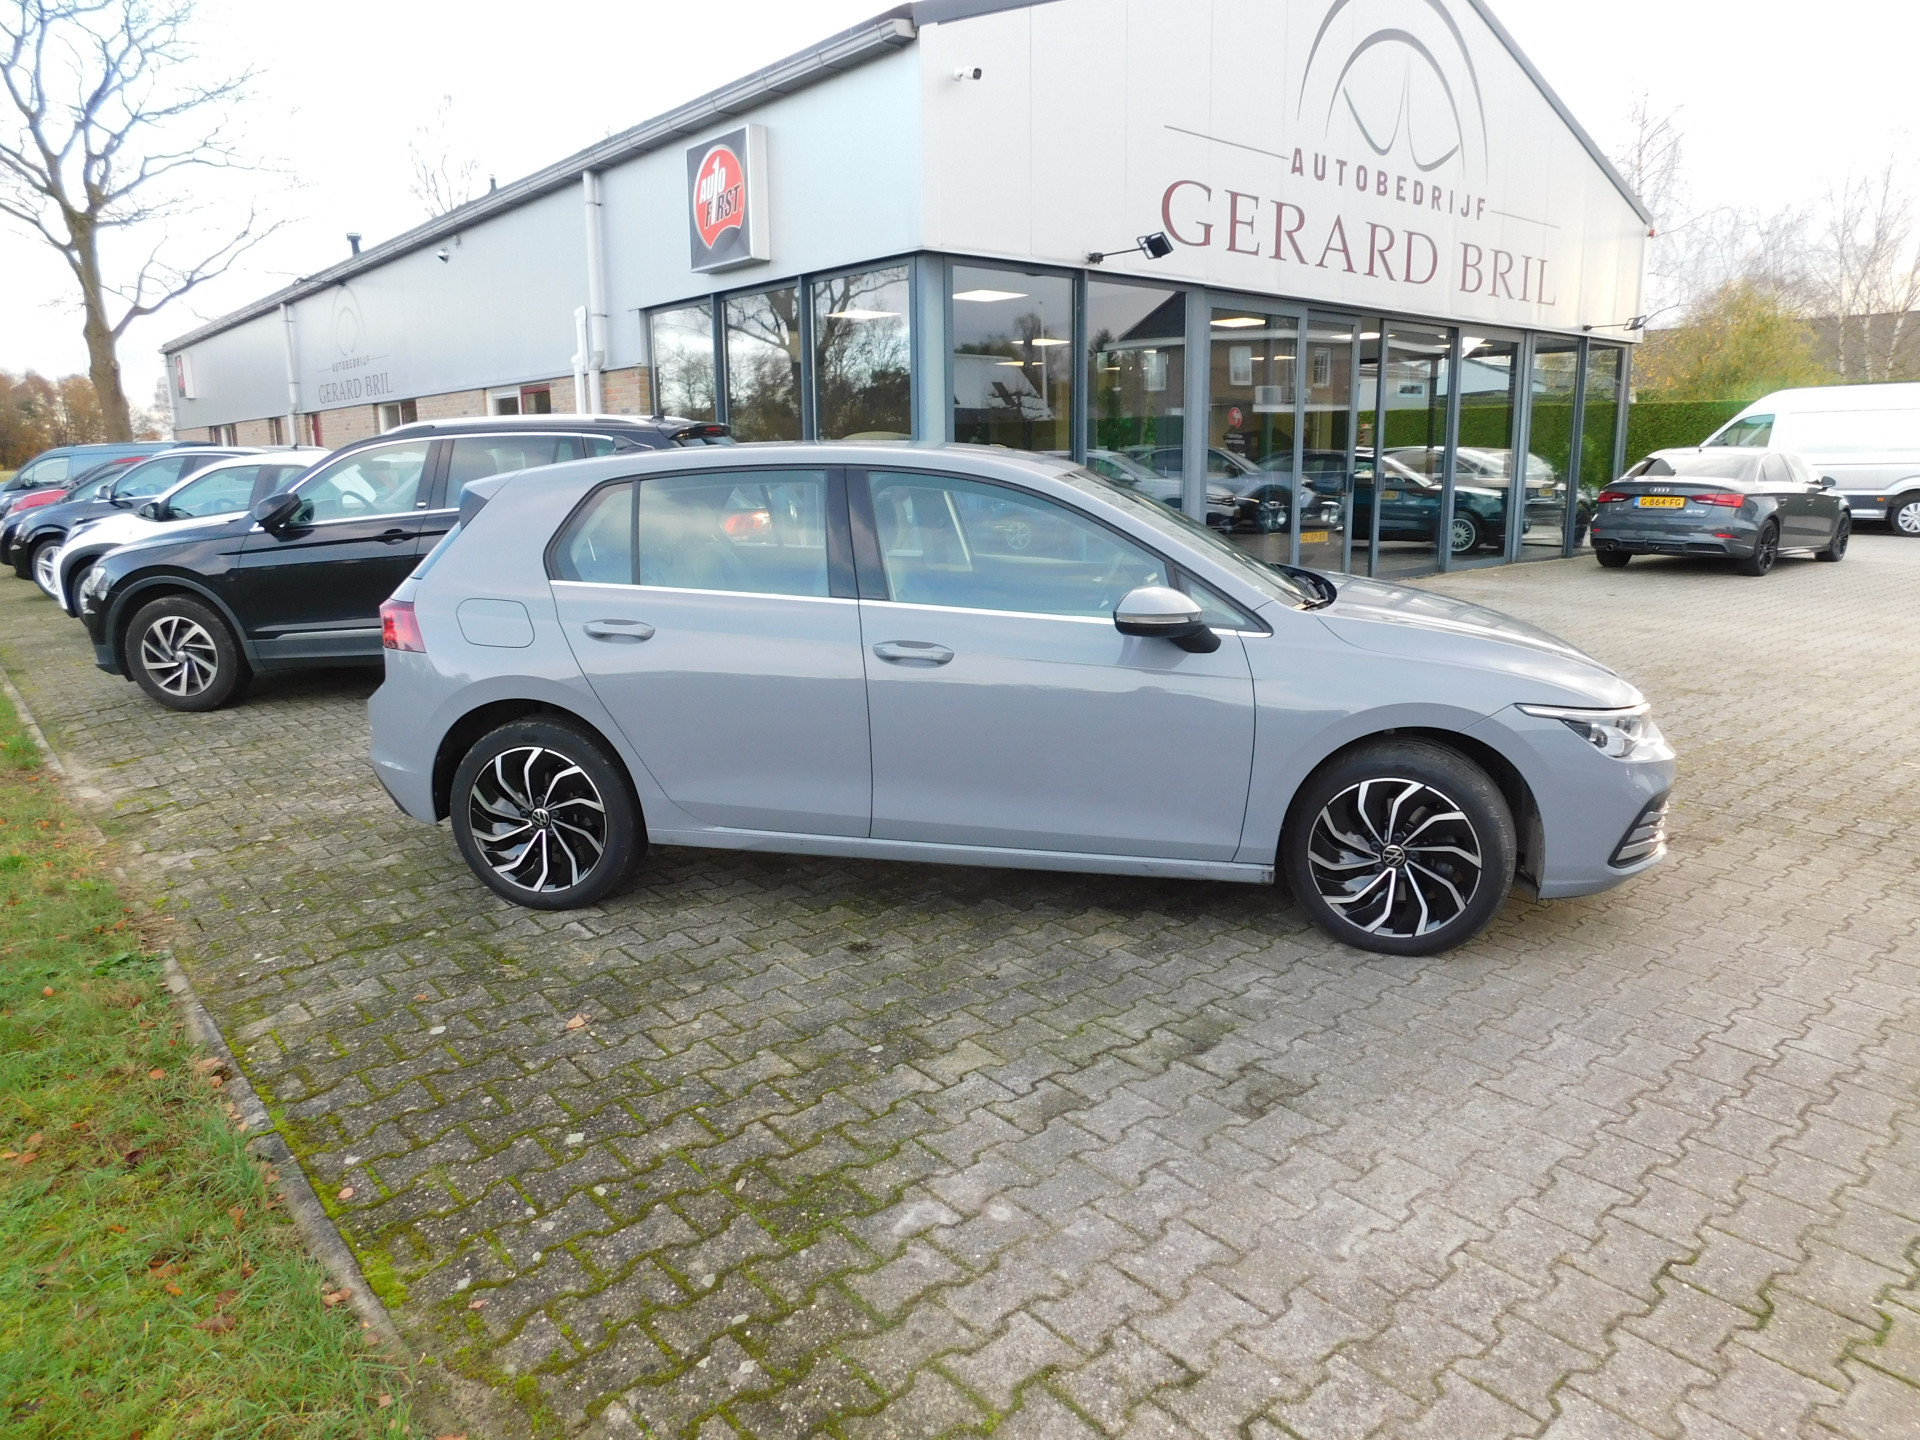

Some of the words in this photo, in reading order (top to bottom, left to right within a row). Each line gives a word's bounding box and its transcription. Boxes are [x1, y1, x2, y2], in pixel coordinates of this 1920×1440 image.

[1290, 146, 1486, 220] AUTOBEDRIJF
[1161, 179, 1438, 285] GERARD
[1459, 241, 1556, 306] BRIL
[332, 354, 370, 373] AUTOBEDRIJF
[318, 378, 362, 404] GERARD
[365, 372, 394, 397] BRIL
[1640, 498, 1681, 506] G-864-FG
